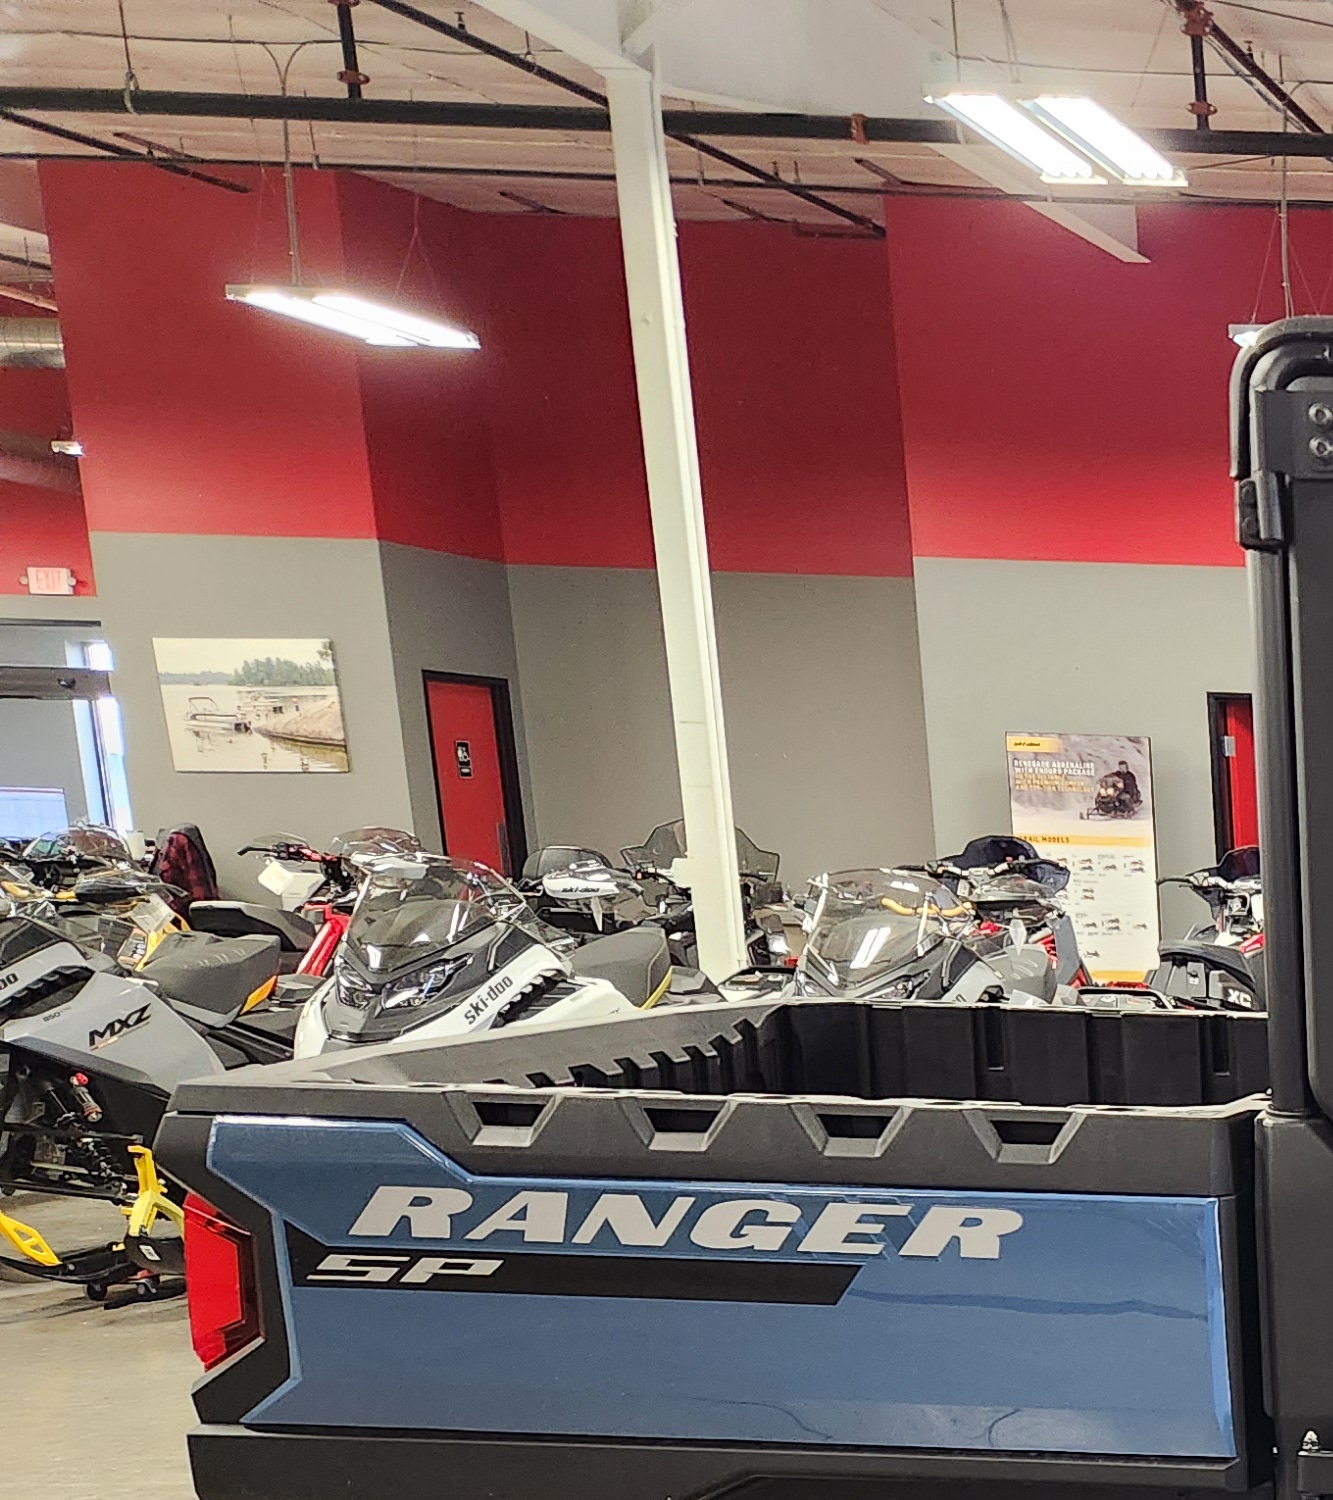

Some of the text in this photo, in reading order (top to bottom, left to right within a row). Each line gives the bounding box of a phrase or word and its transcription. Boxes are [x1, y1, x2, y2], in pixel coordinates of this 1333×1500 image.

[36, 569, 62, 591] EXIT
[1042, 836, 1070, 844] MODELS
[464, 975, 514, 1025] ski-doo
[89, 1002, 152, 1047] MXZ
[348, 1184, 1024, 1259] RANGER
[306, 1253, 504, 1284] SP
